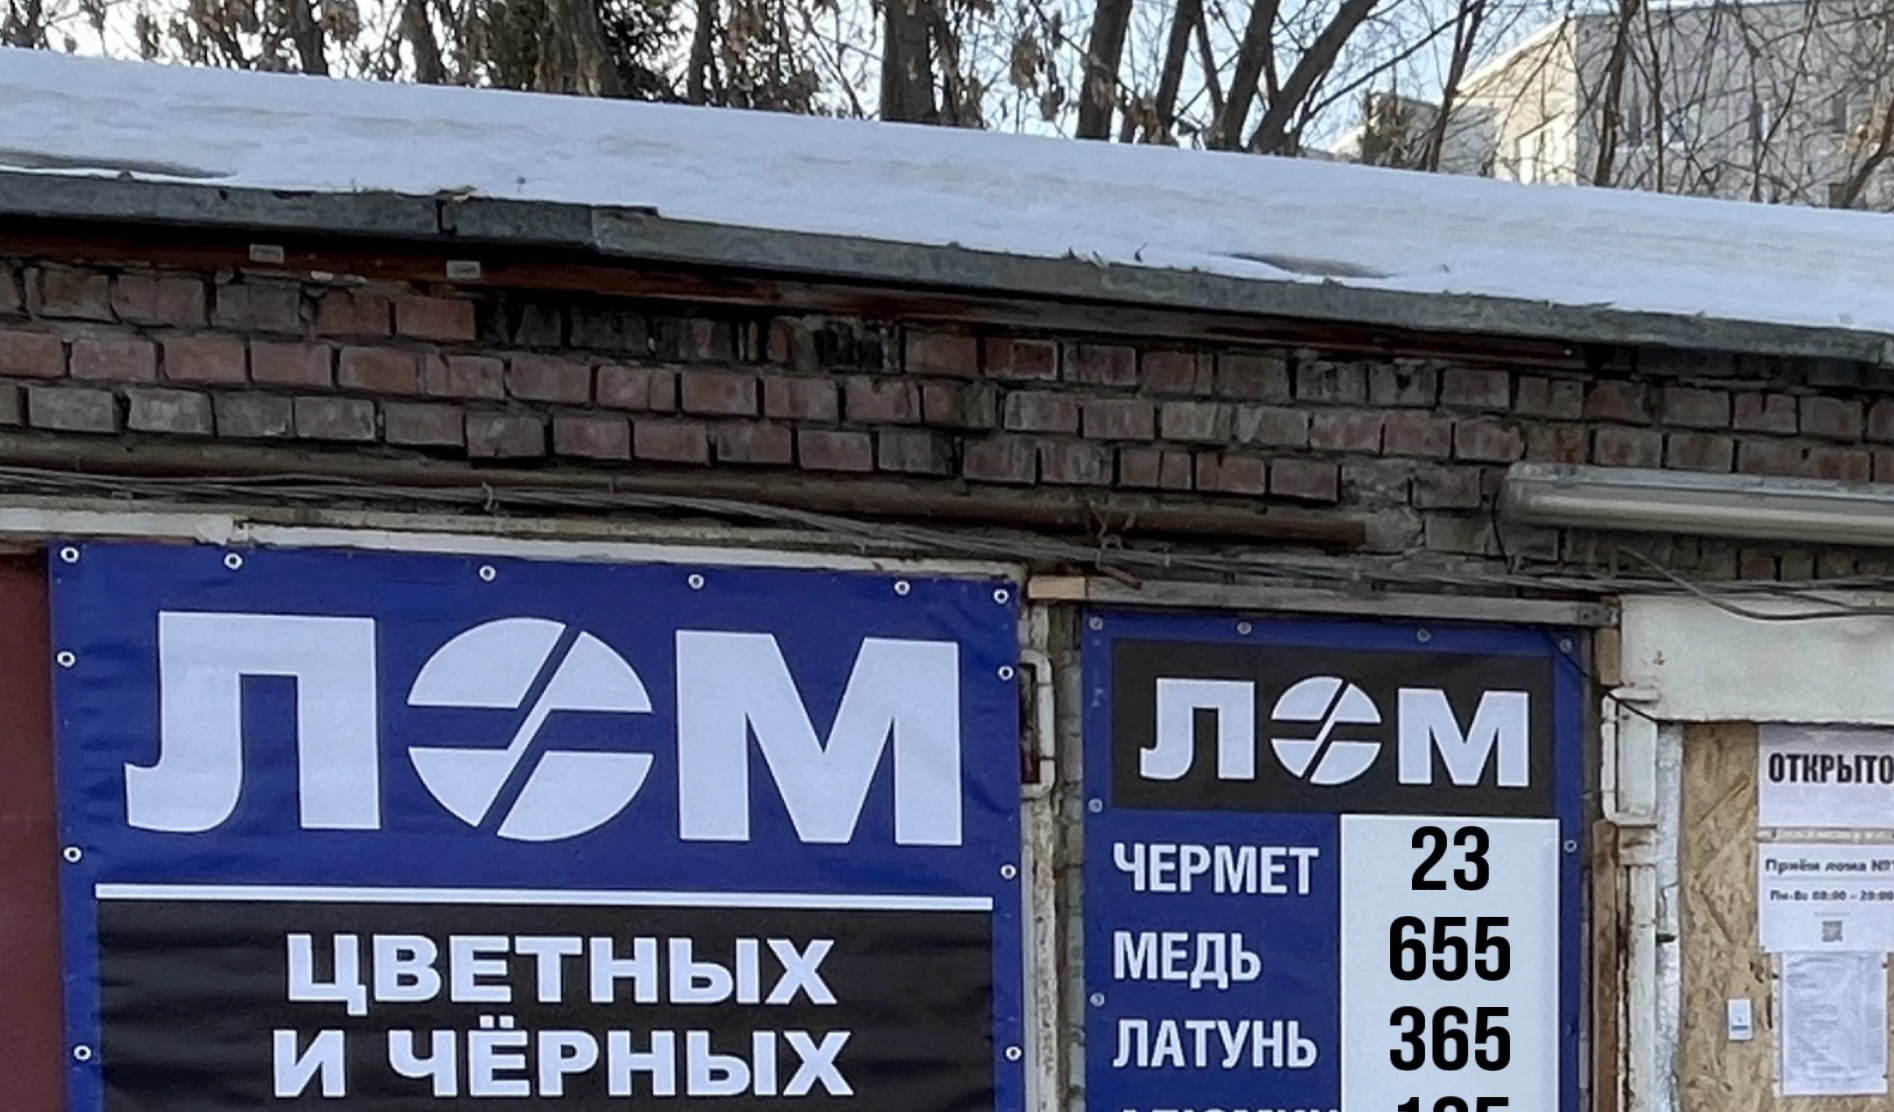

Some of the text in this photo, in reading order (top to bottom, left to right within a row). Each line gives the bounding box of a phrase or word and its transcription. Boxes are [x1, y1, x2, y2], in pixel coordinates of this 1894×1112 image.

[125, 610, 962, 846] ЛОМ
[1140, 676, 1529, 787] ЛОМ
[1769, 752, 1894, 784] ОТКРЫТО
[1114, 825, 1490, 894] ЧЕРМЕТ 23
[1765, 858, 1820, 875] Приём
[1825, 861, 1867, 872] лома
[287, 934, 837, 1016] ЦВЕТНЫХ
[1114, 915, 1511, 989] МЕДЬ 655
[273, 1015, 854, 1098] И ЧЁРНЫХ
[1113, 1005, 1511, 1072] ЛАТУНЬ 365
